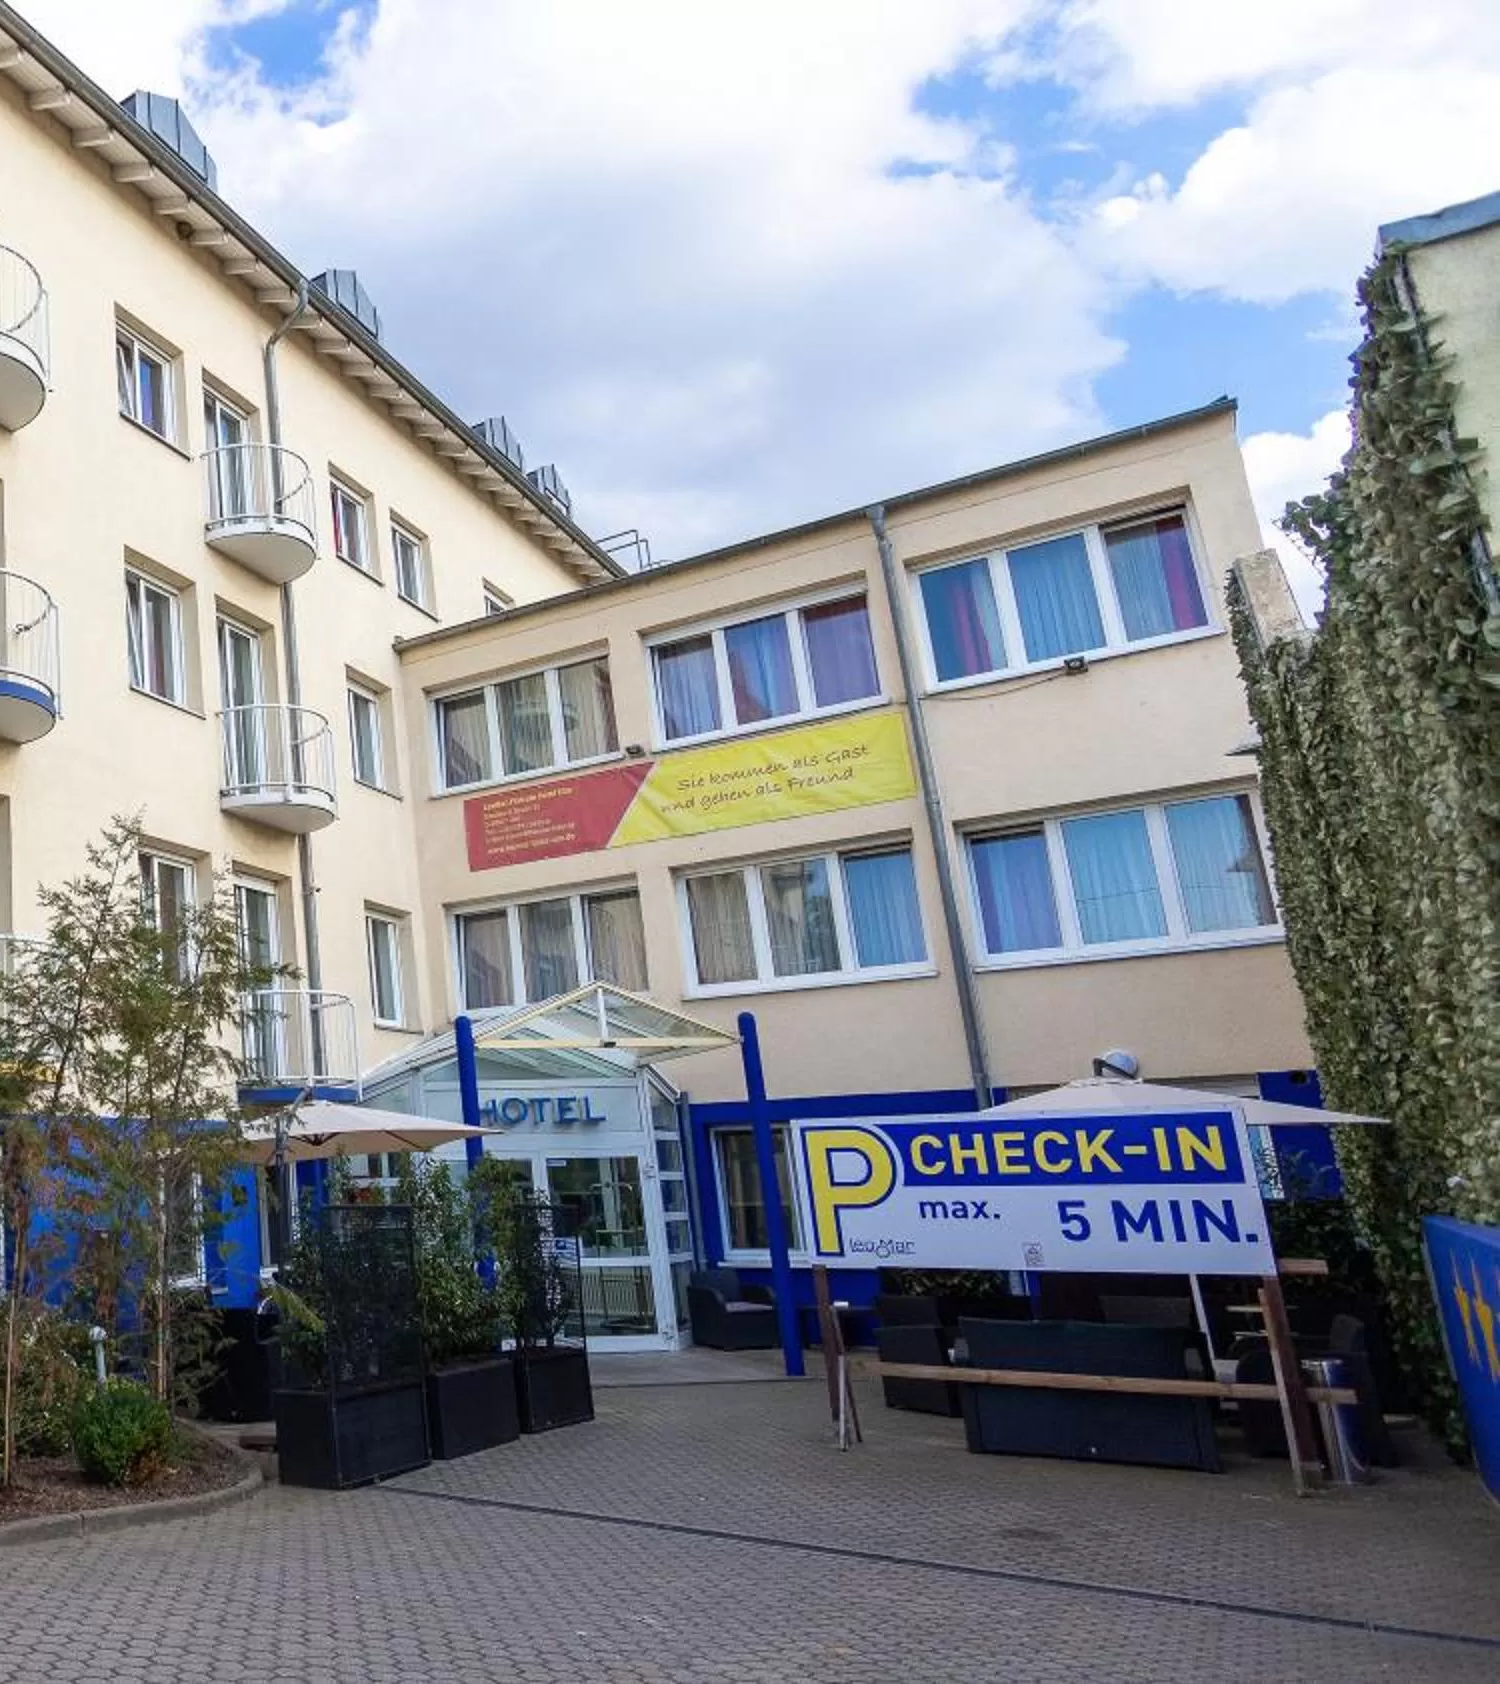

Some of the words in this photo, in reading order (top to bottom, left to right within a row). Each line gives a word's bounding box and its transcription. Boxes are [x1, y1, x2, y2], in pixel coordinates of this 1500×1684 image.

[677, 773, 705, 791] Sie
[709, 763, 789, 785] kommen
[793, 755, 820, 769] als
[825, 744, 871, 764] Gast
[700, 789, 751, 812] gehen
[756, 781, 783, 795] als
[787, 766, 854, 792] Freund
[480, 1096, 607, 1125] HOTEL
[910, 1125, 1228, 1176] CHECK-IN
[802, 1126, 897, 1257] P
[919, 1200, 1001, 1220] max.
[1057, 1200, 1091, 1242] 5
[1111, 1199, 1260, 1243] MIN.
